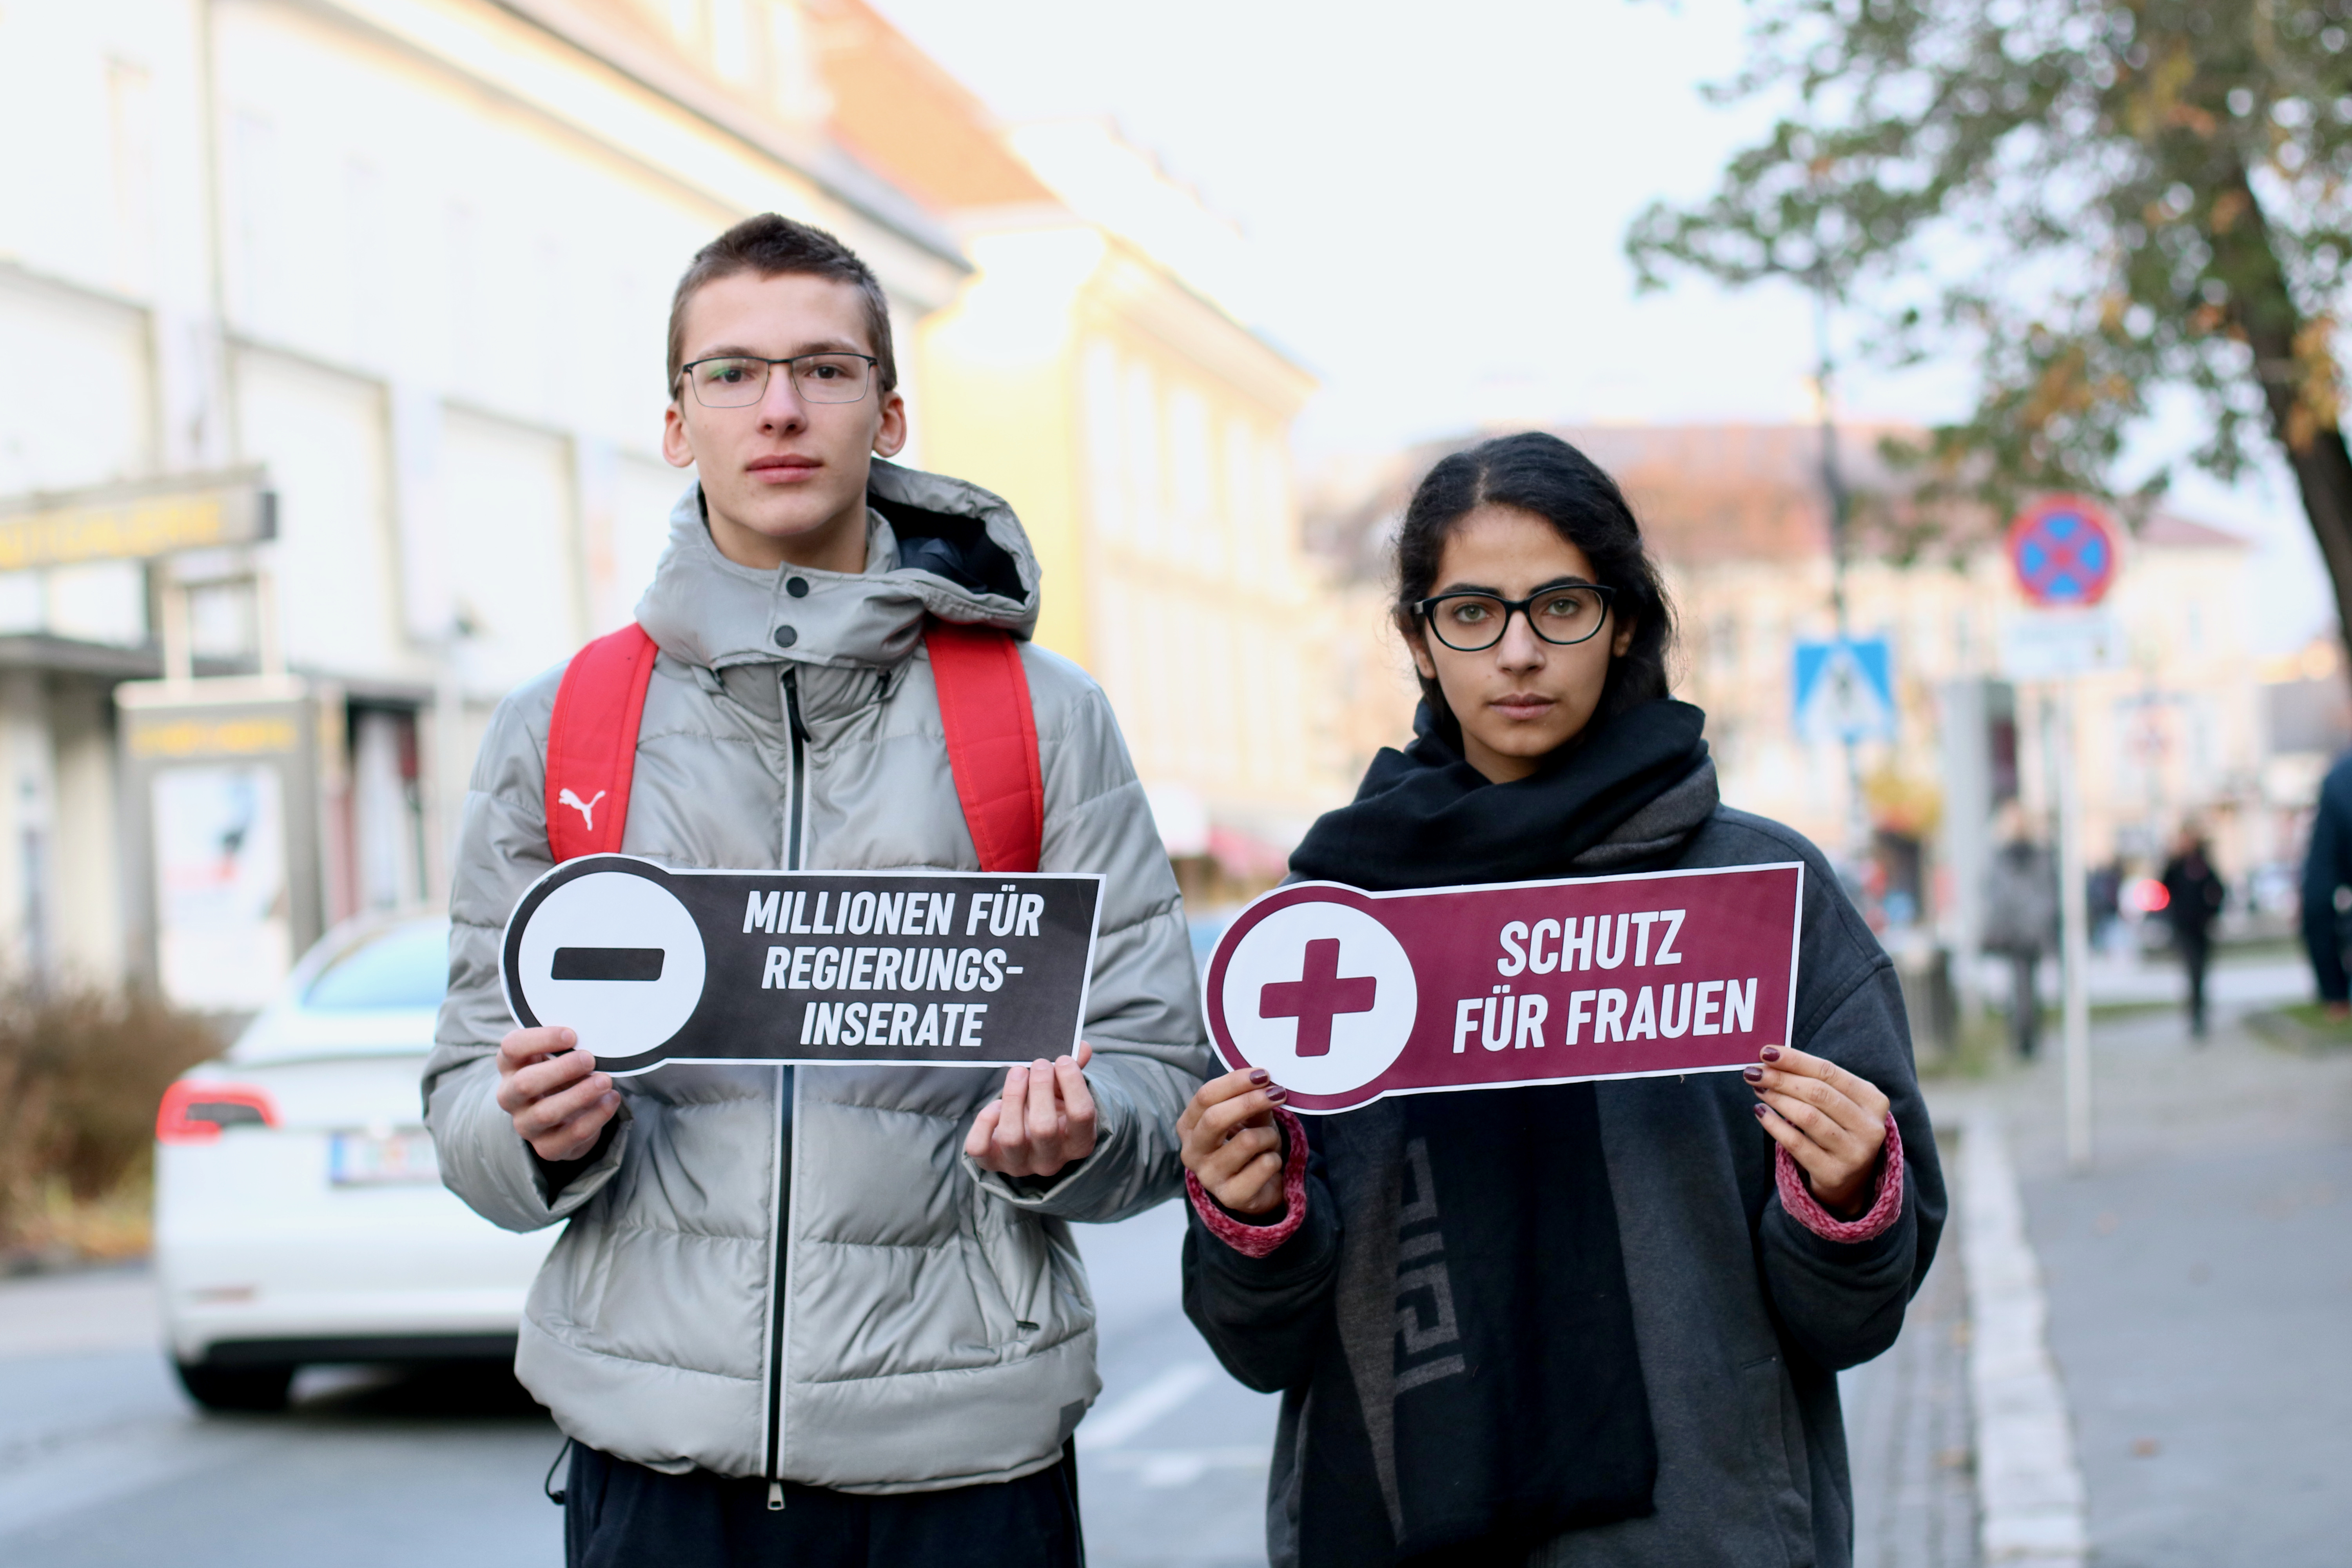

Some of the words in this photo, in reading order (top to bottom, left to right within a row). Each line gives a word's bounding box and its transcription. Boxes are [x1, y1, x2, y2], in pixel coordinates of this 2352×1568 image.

[742, 890, 956, 936] MILLIONEN
[965, 884, 1045, 937] FÜR
[761, 946, 1024, 992] REGIERUNGS-
[1497, 909, 1686, 977] SCHUTZ
[800, 1002, 988, 1047] INSERATE
[1452, 984, 1549, 1054] FÜR
[1565, 977, 1758, 1045] FRAUEN
